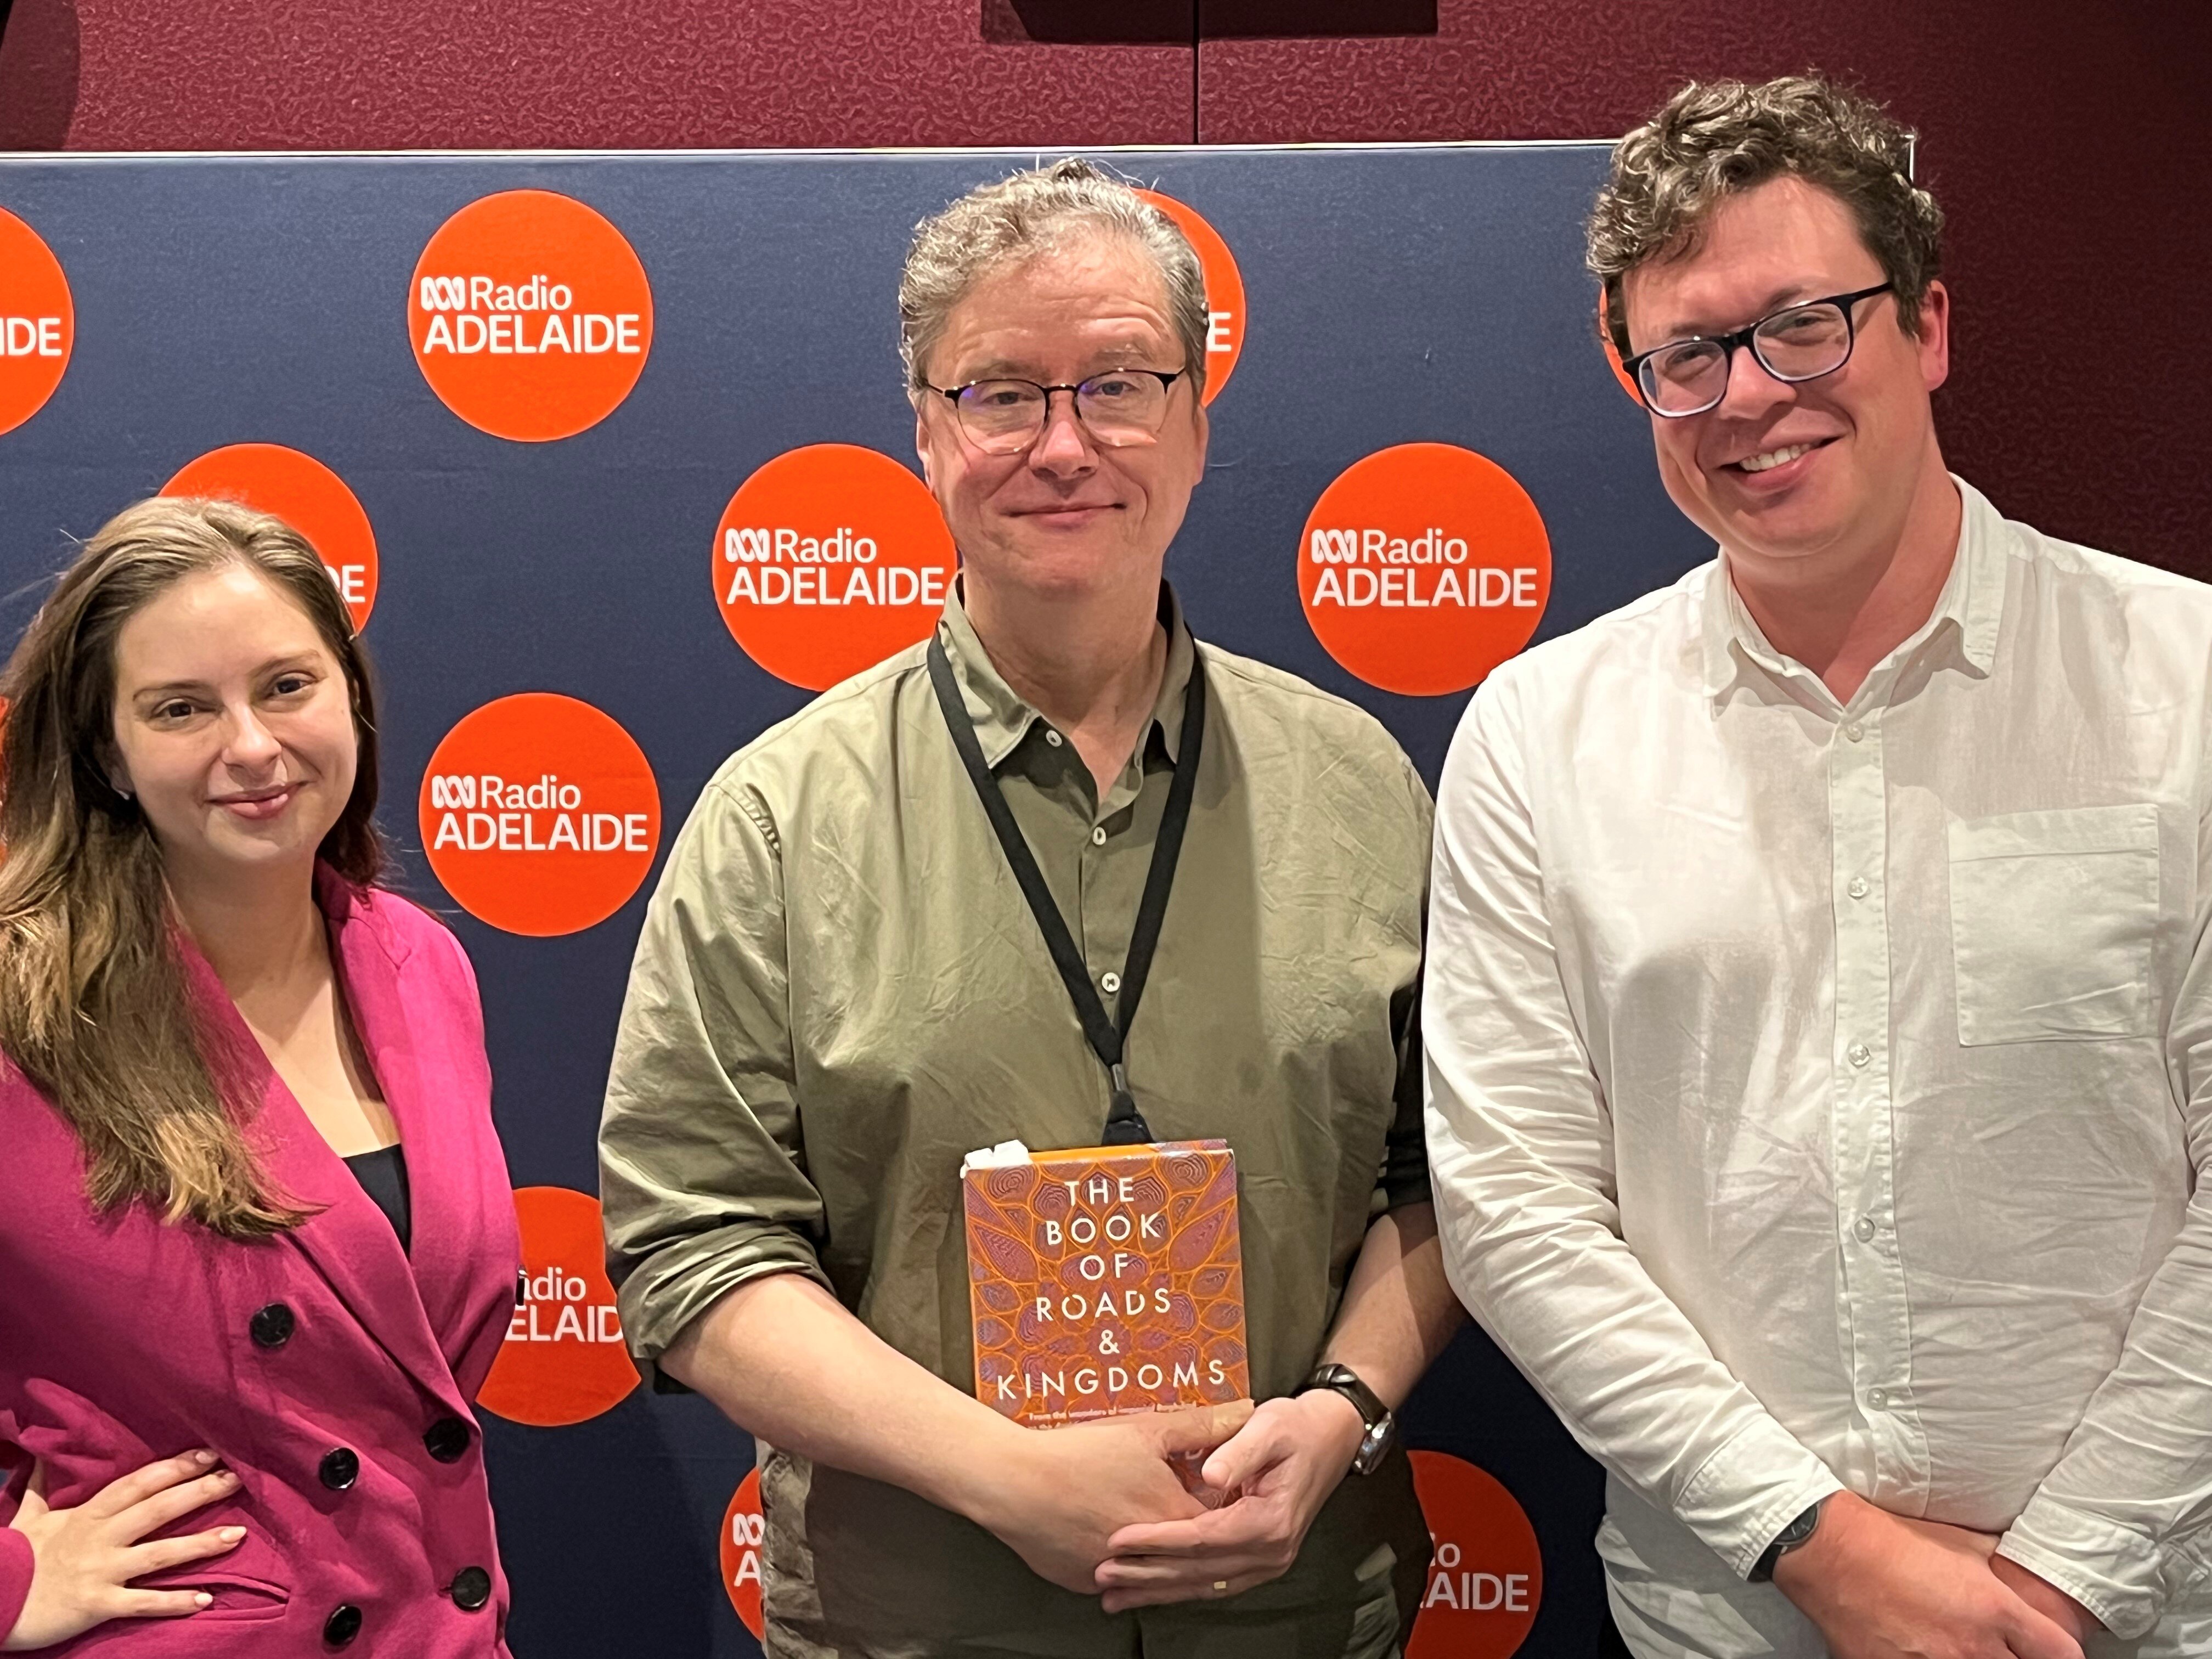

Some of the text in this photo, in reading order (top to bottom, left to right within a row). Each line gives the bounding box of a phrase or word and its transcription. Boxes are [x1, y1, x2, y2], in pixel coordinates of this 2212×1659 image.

[470, 274, 572, 311] Radio
[423, 314, 640, 354] ADELAIDE
[775, 527, 877, 563] Radio
[1363, 528, 1468, 564] Radio
[726, 566, 944, 606] ADELAIDE
[1312, 568, 1537, 607] ADELAIDE
[481, 775, 581, 810] Radio
[433, 812, 648, 851] ADELAIDE
[1064, 1177, 1135, 1206] THE
[1046, 1211, 1161, 1245] BOOK
[1079, 1252, 1129, 1280] OF
[1036, 1288, 1171, 1322] ROADS
[1098, 1329, 1120, 1355] &
[997, 1359, 1225, 1400] KINGDOMS
